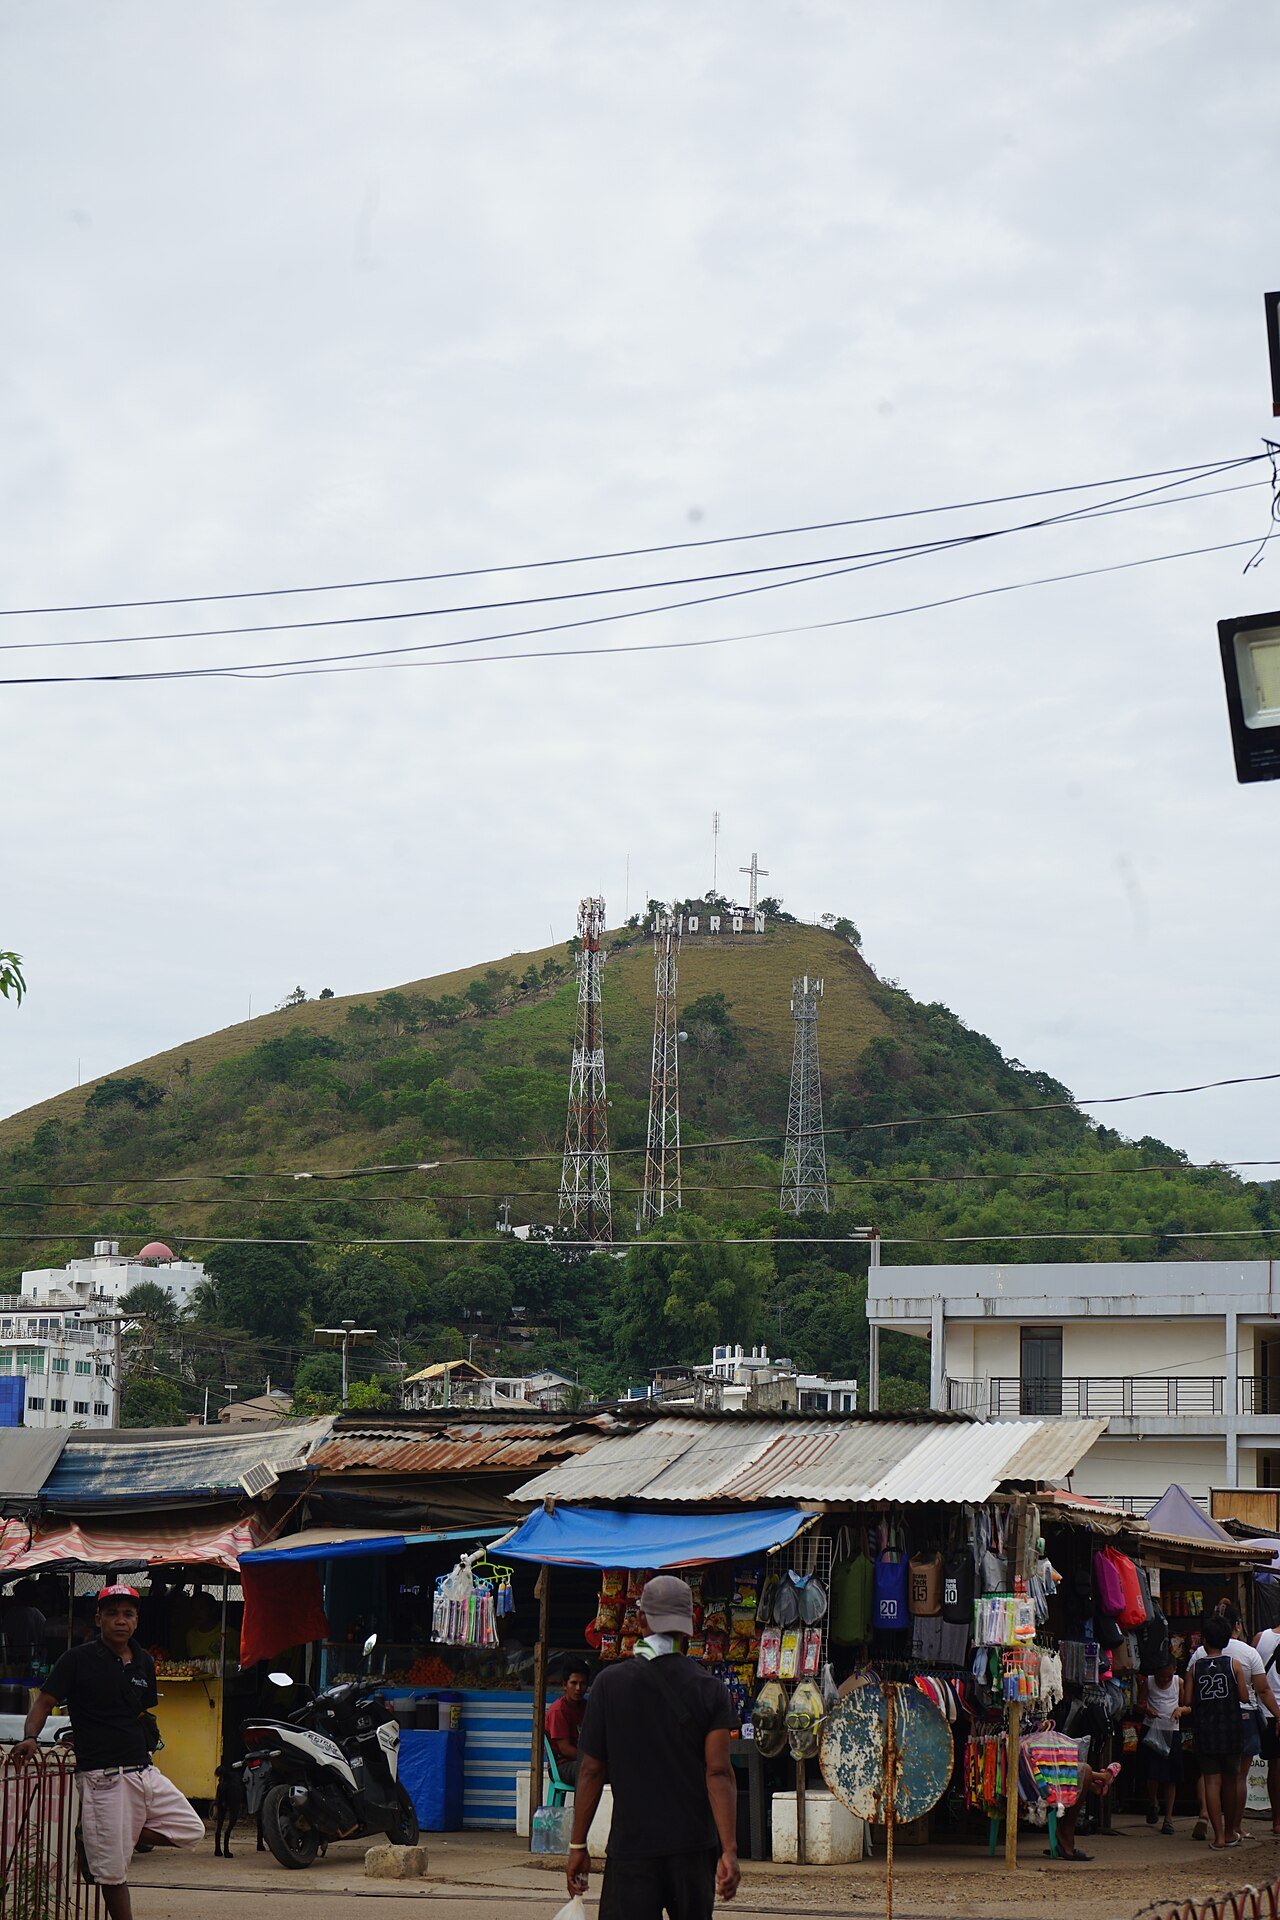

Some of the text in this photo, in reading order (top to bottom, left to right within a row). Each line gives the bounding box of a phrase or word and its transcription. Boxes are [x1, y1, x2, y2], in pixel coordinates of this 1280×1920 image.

[667, 916, 765, 933] ORON
[0, 1328, 16, 1339] TOP
[913, 1586, 927, 1601] 15
[945, 1590, 957, 1602] 10
[881, 1601, 896, 1615] 20
[1199, 1673, 1229, 1700] 23
